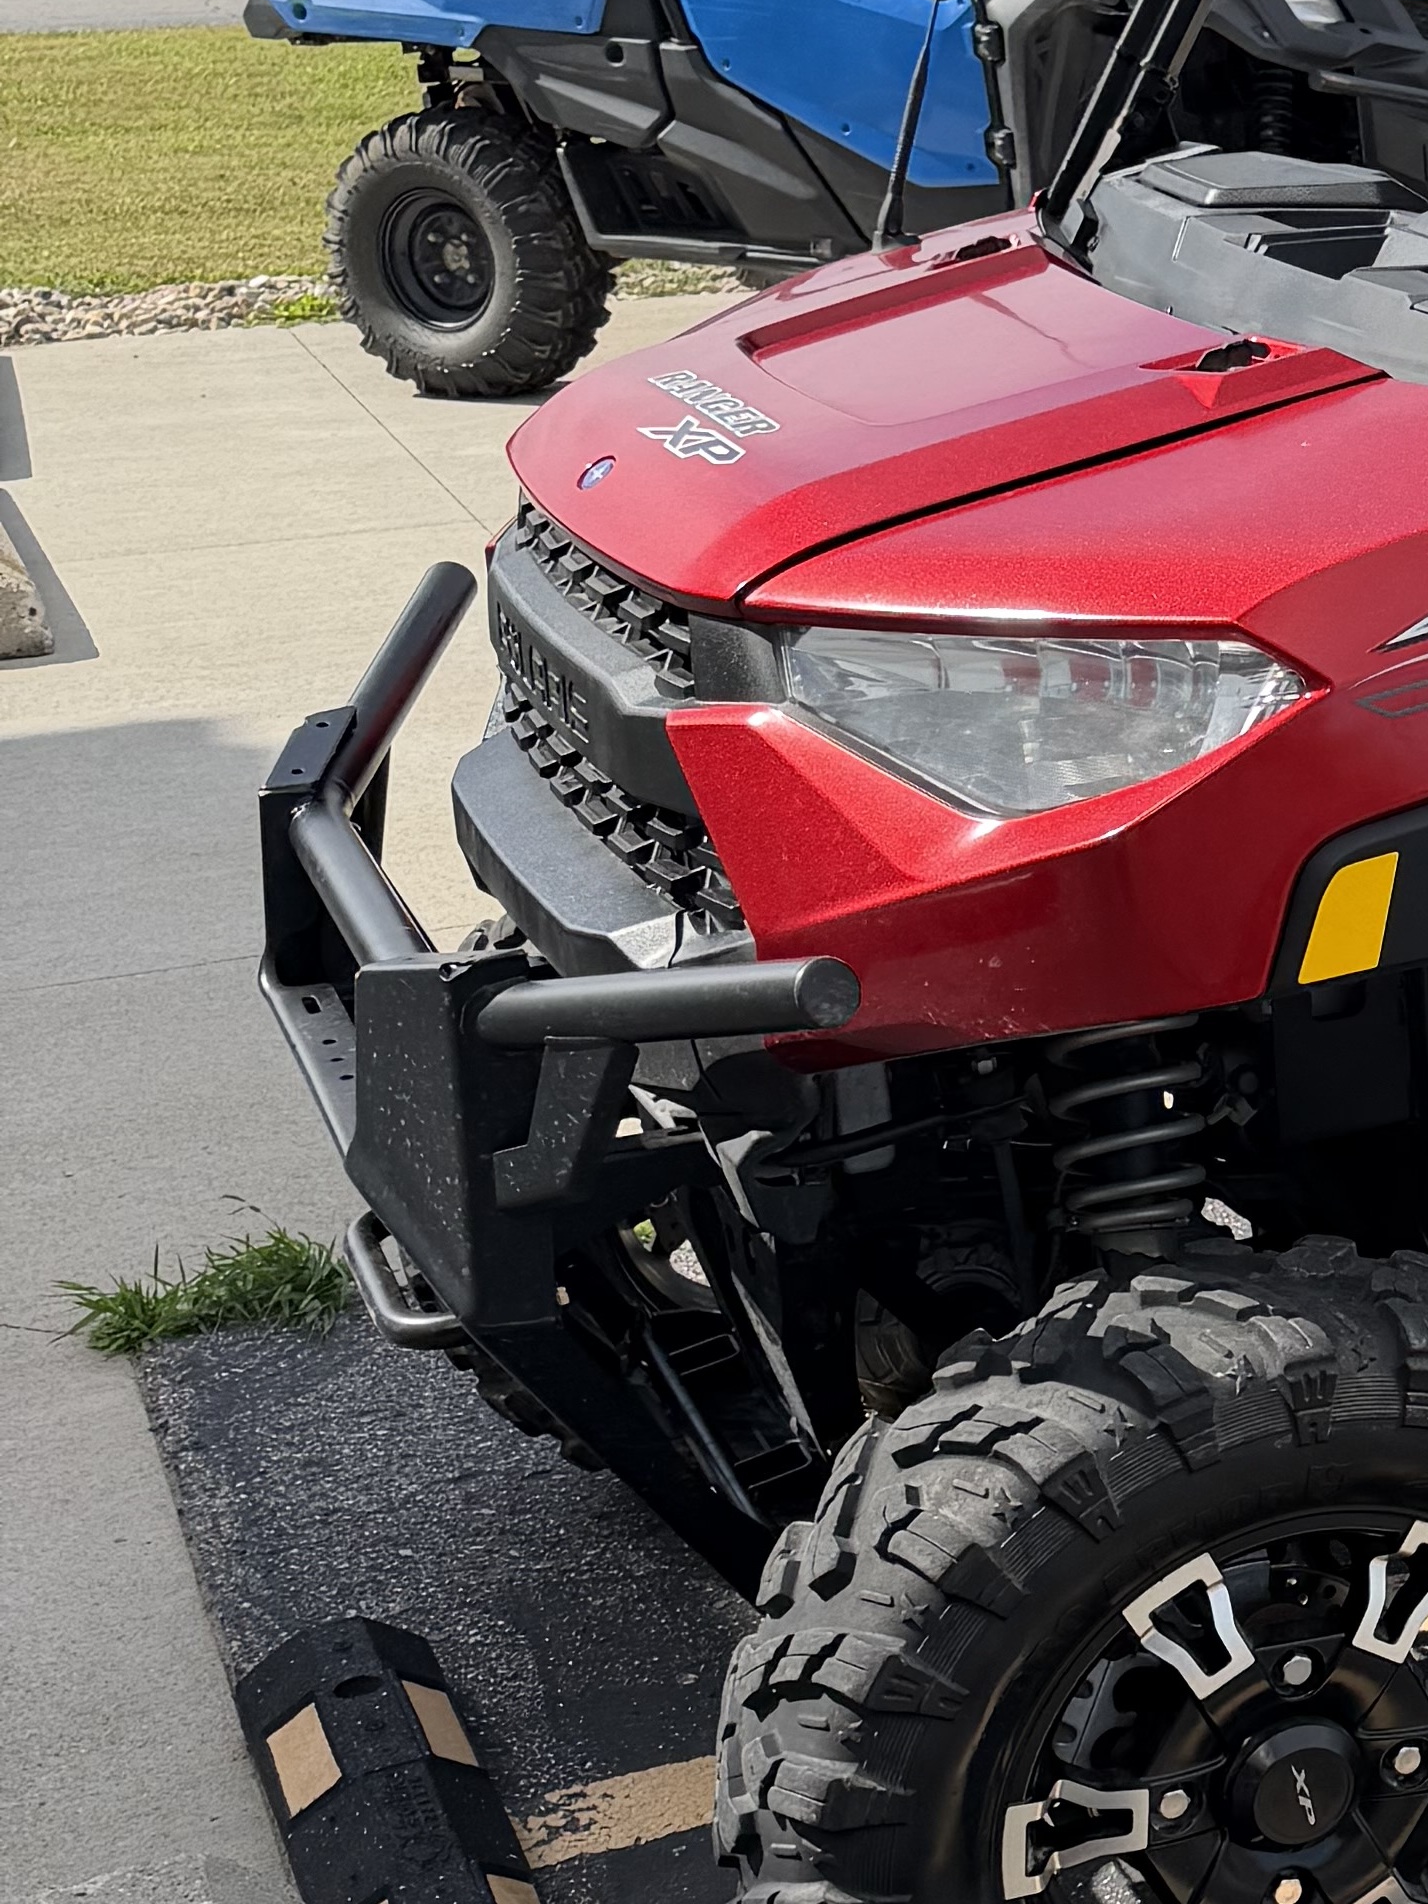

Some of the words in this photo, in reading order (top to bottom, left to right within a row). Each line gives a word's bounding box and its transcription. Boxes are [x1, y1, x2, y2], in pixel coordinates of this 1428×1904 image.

[647, 370, 781, 438] RANGER
[636, 414, 747, 465] XP
[1290, 1763, 1316, 1826] XP
